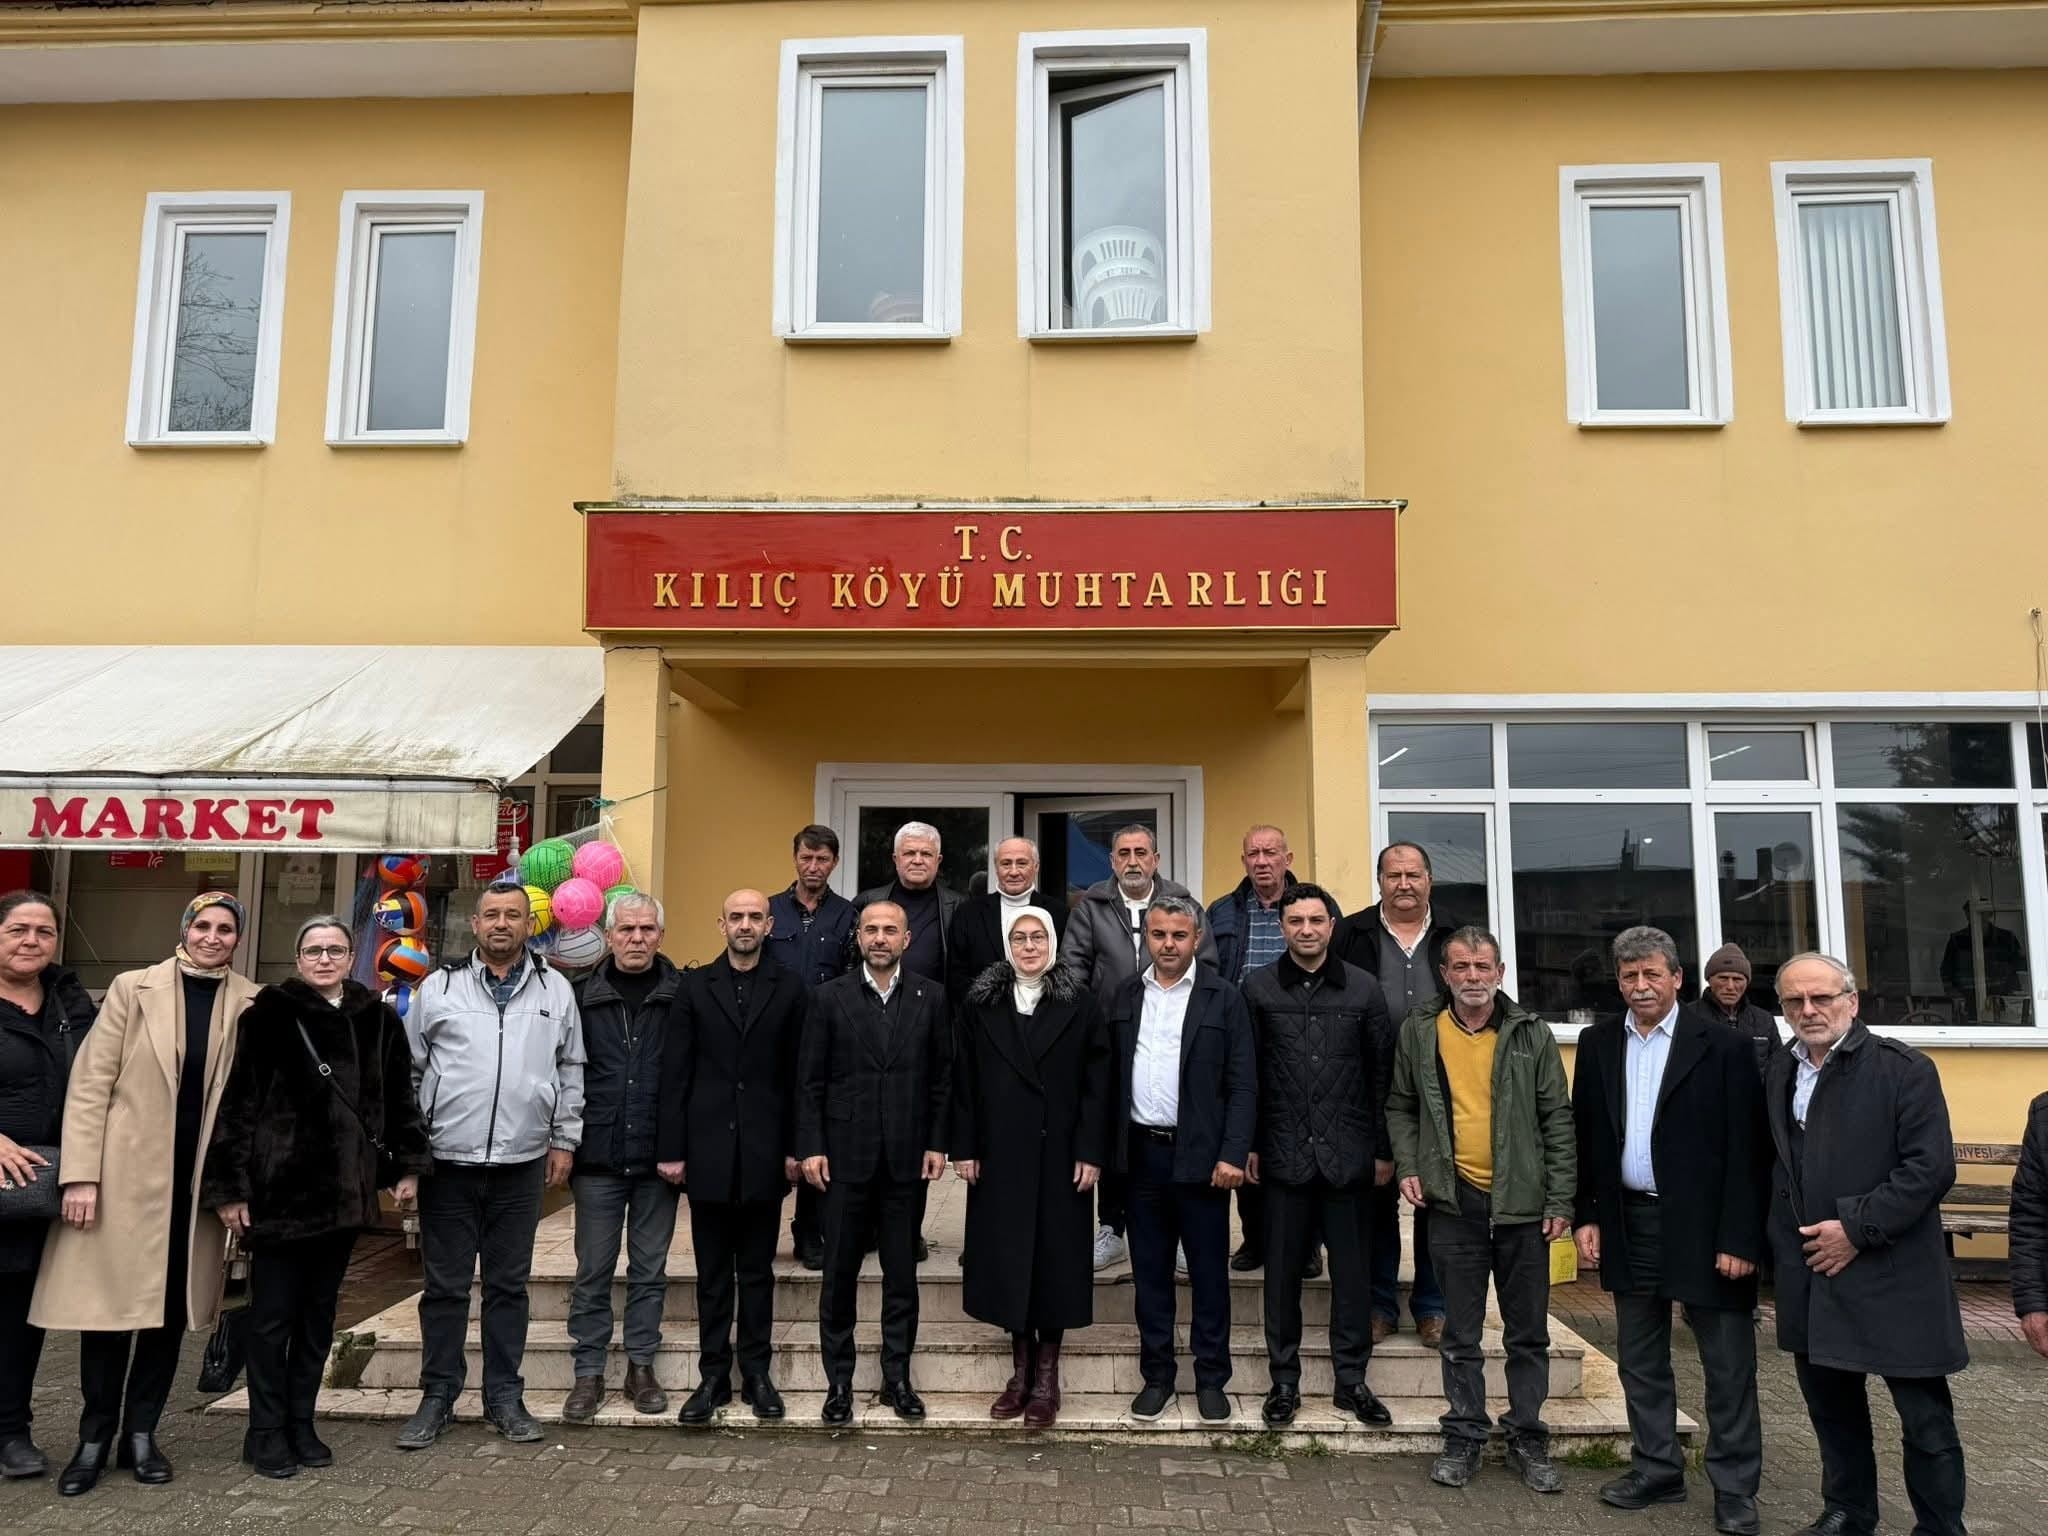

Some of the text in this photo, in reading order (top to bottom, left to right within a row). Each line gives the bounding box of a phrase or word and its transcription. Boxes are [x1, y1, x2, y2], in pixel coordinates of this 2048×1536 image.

[653, 565, 1327, 615] KILIÇ KÖYÜ MUHTARLIĞI
[28, 796, 335, 842] MARKET
